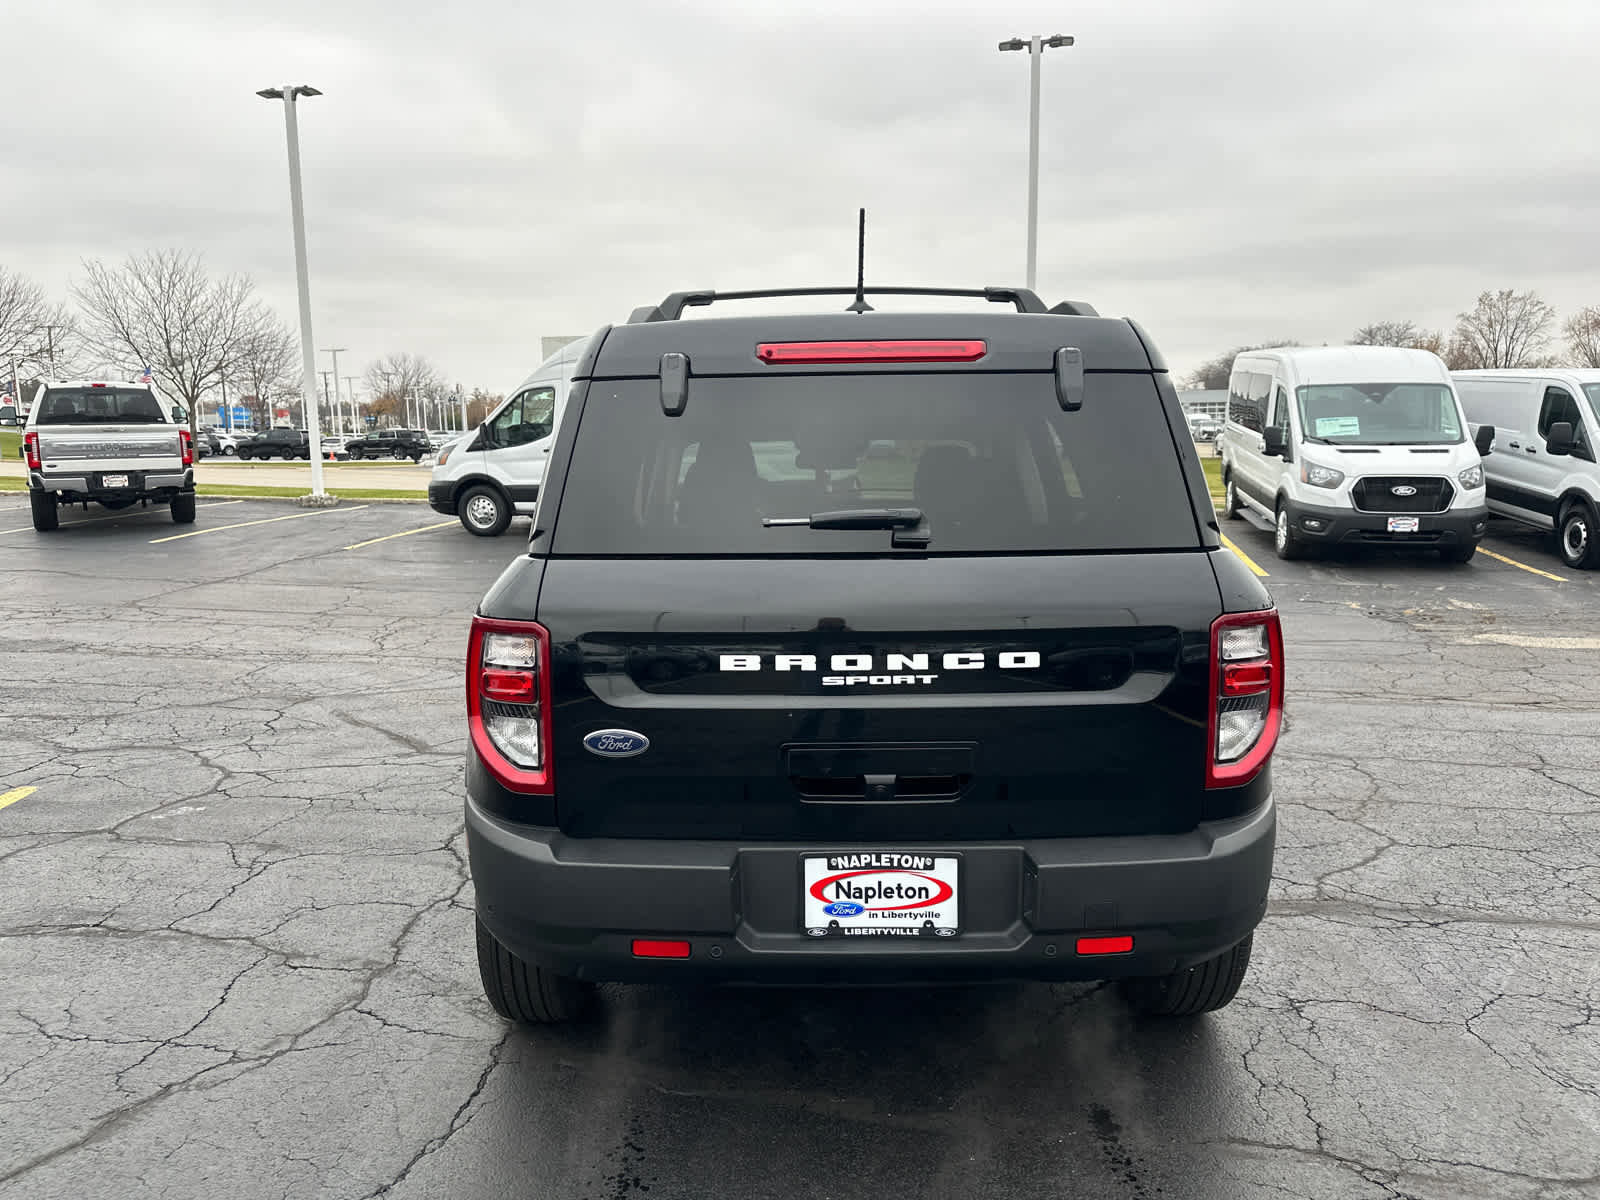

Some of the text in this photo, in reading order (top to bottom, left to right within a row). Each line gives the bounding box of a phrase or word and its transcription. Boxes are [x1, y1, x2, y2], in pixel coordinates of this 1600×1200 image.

[719, 651, 1040, 671] BRONCO
[822, 674, 938, 685] SPORT
[598, 734, 633, 750] Ford
[837, 853, 926, 869] NAPLETON
[835, 880, 930, 904] Napleton
[831, 902, 857, 916] Ford
[868, 911, 941, 921] in Libertyville
[844, 928, 920, 936] LIBERTYVILLE
